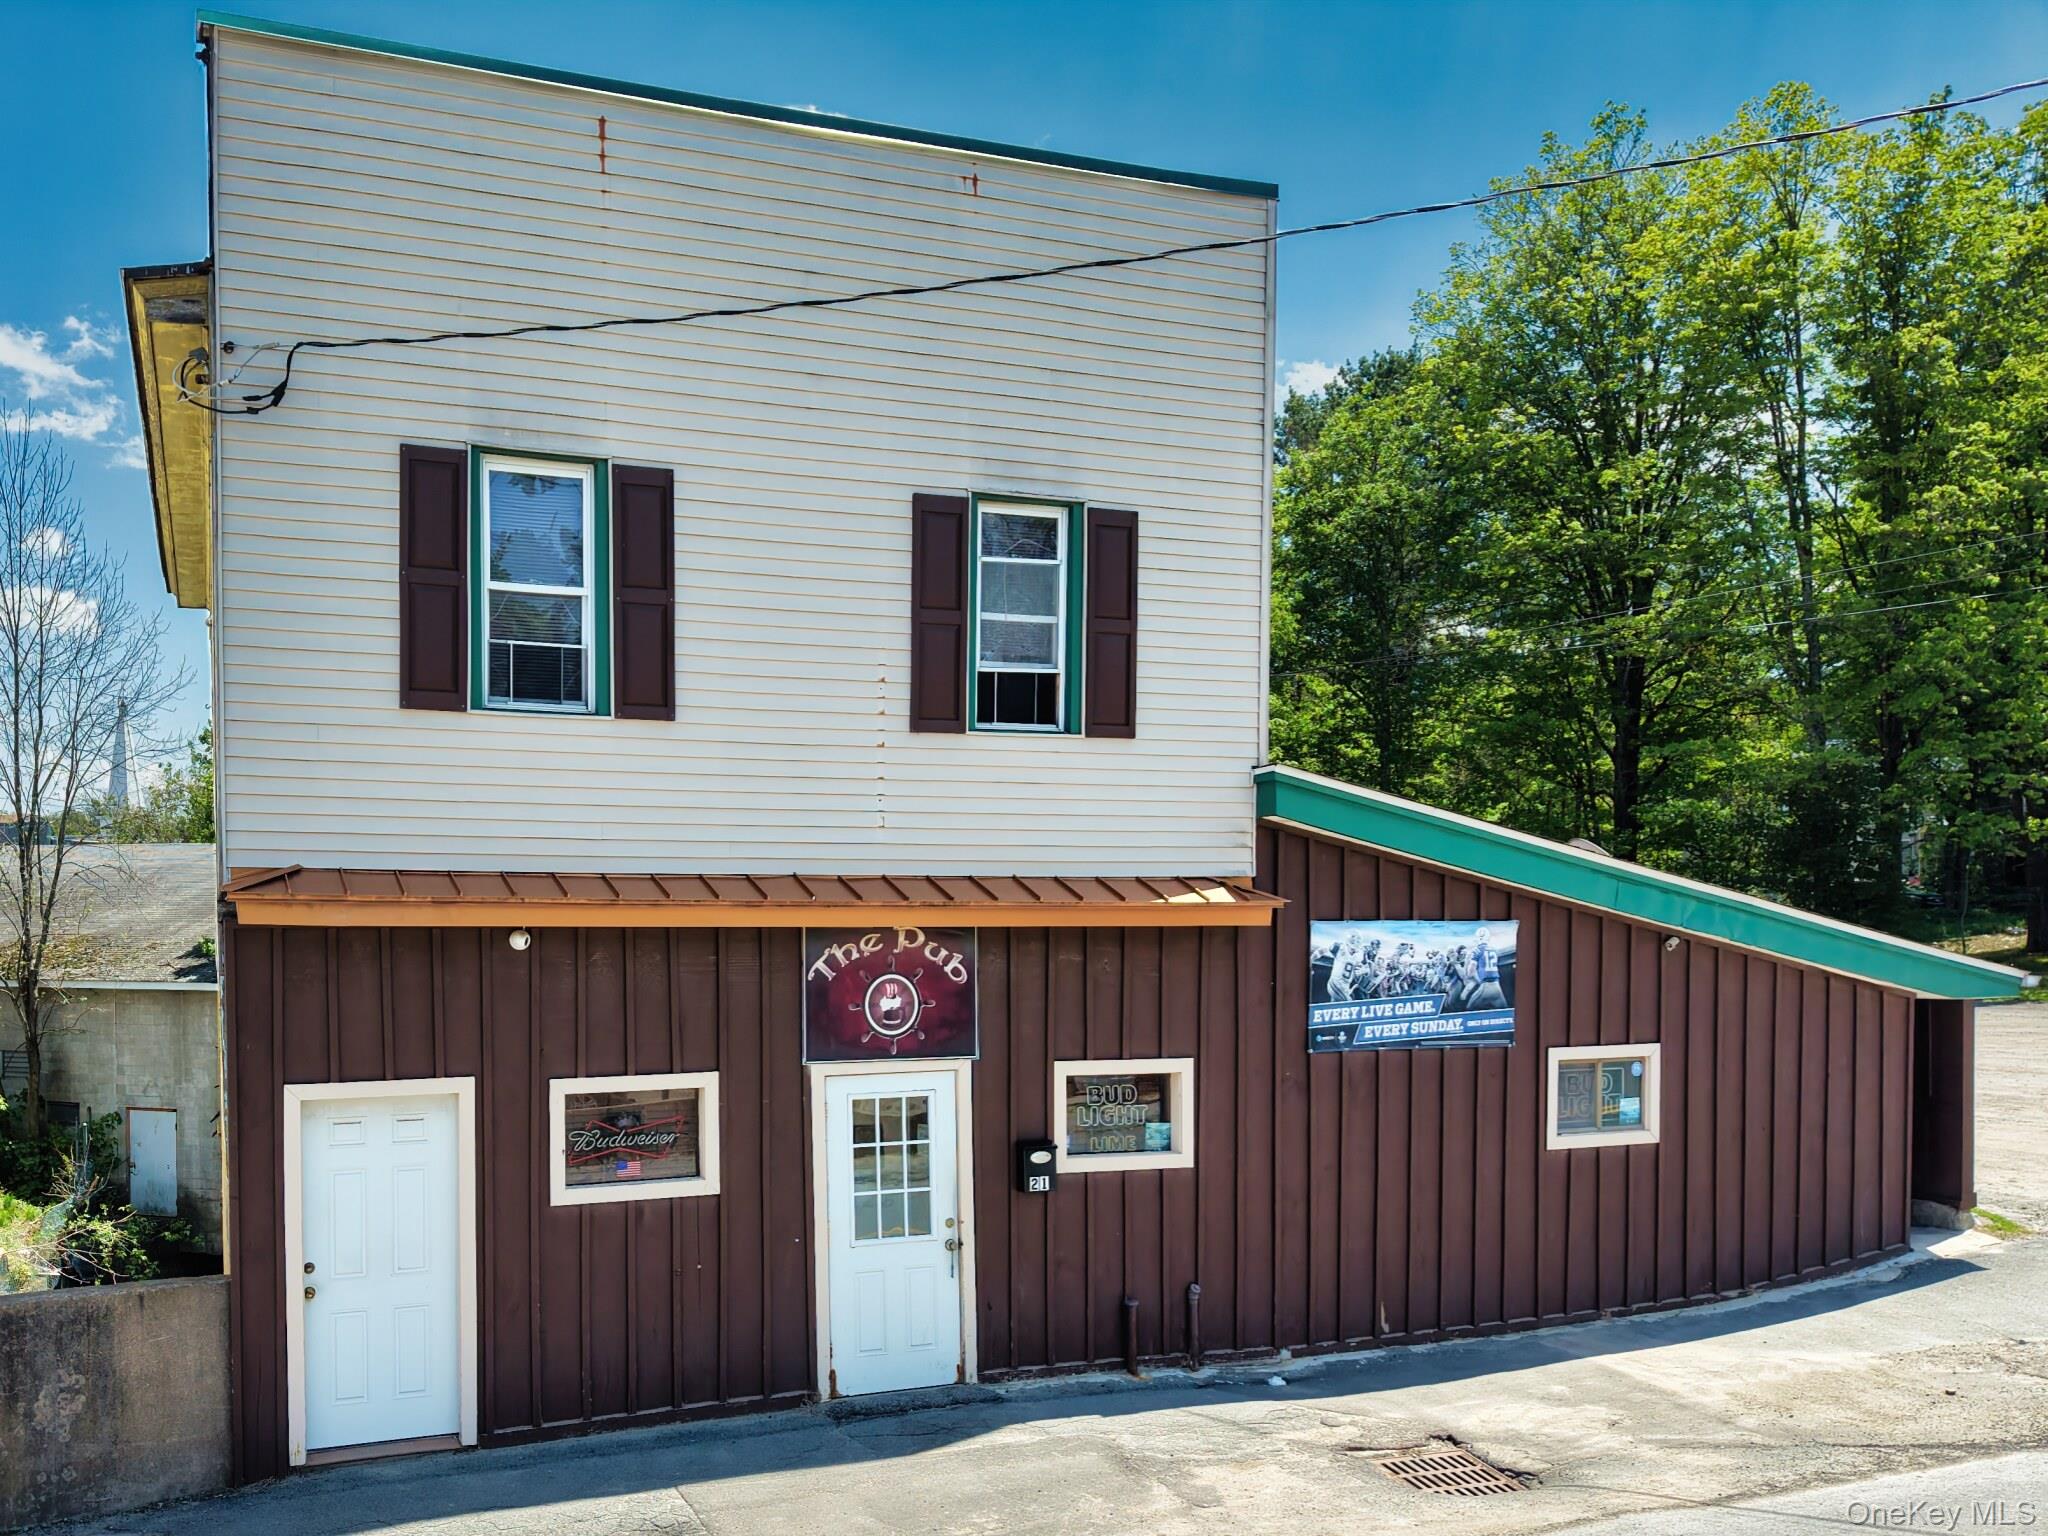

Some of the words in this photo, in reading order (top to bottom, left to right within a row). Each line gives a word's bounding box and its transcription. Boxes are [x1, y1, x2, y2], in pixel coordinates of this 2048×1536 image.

[807, 933, 884, 981] The
[893, 926, 968, 984] Pub
[1313, 1006, 1361, 1022] EVERY
[1361, 1003, 1394, 1018] LIVE
[1395, 1001, 1436, 1015] GAME.
[1364, 1022, 1410, 1038] EVERY
[1411, 1018, 1464, 1034] SUNDAY.
[1087, 1085, 1137, 1106] BUD
[1077, 1105, 1149, 1127] LIGHT
[568, 1129, 681, 1151] Budweiser
[1090, 1135, 1137, 1152] LIME
[1030, 1177, 1049, 1191] 21
